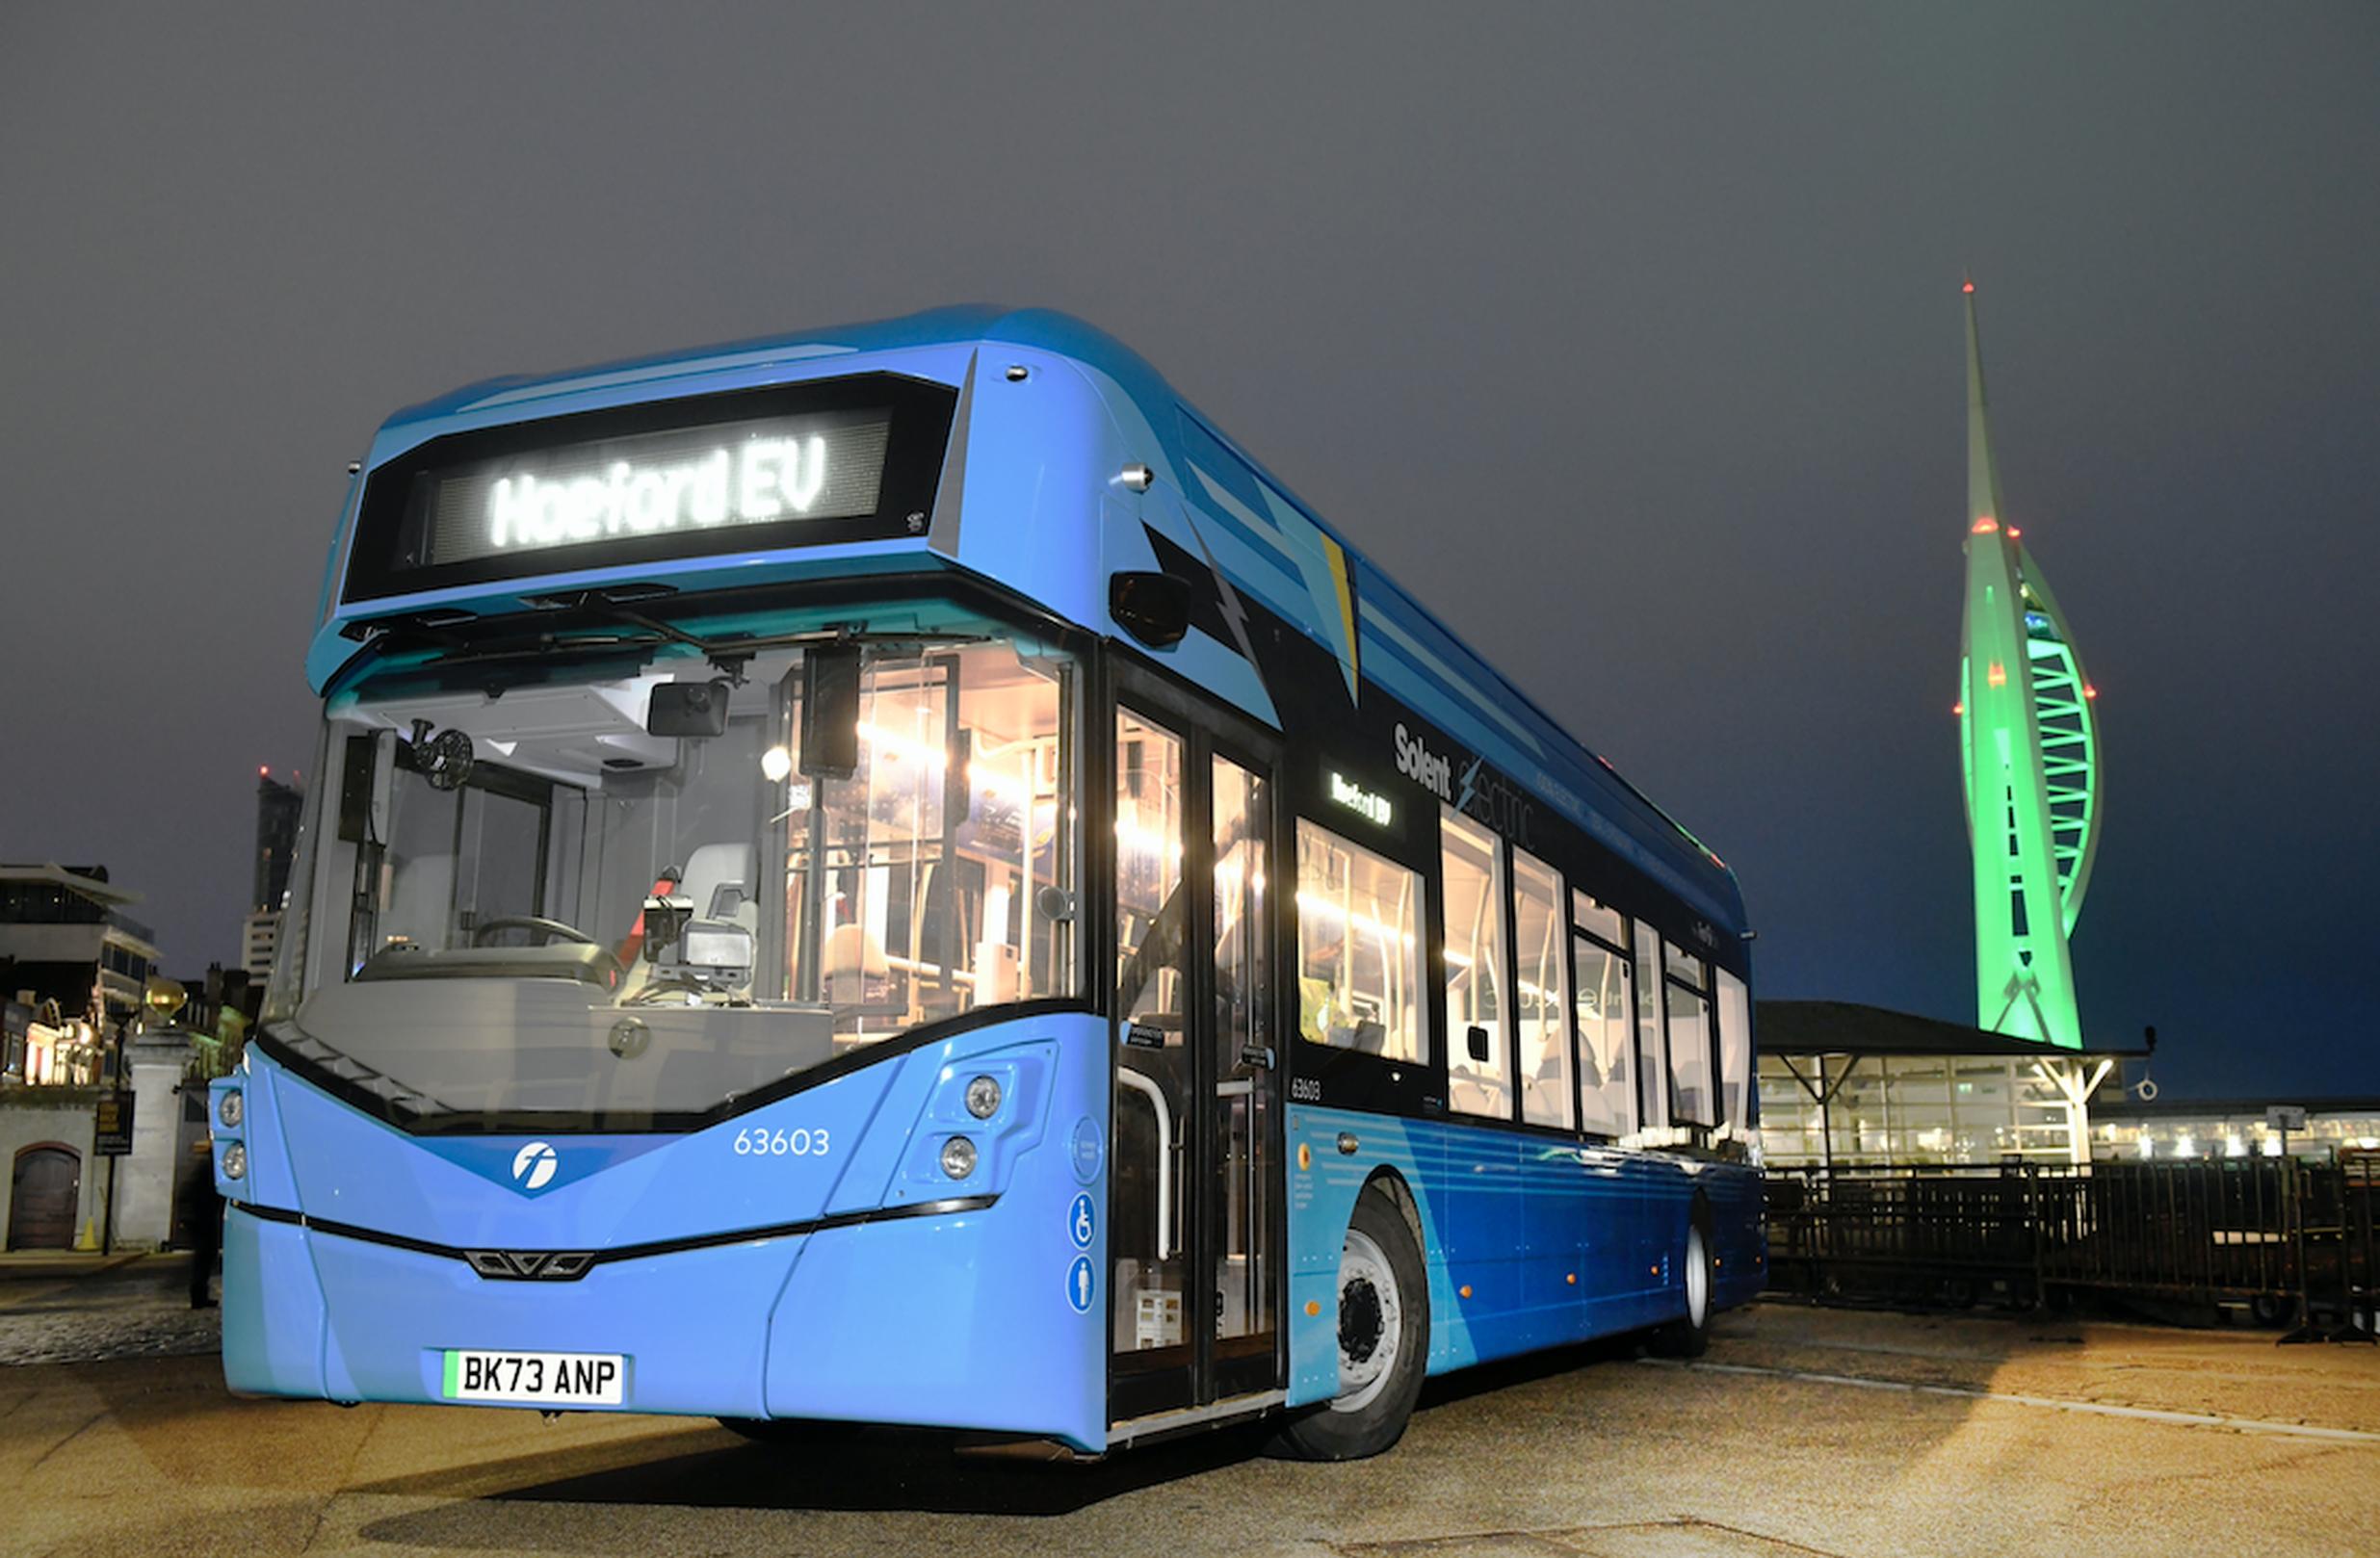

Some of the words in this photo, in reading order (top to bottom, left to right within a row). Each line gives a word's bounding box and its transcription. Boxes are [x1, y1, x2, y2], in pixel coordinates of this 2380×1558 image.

[740, 434, 825, 518] EV
[1396, 723, 1452, 801] Solent
[1292, 1078, 1321, 1101] 63603
[734, 1128, 829, 1156] 63603
[464, 1357, 543, 1392] BK73
[554, 1360, 615, 1395] ANP
